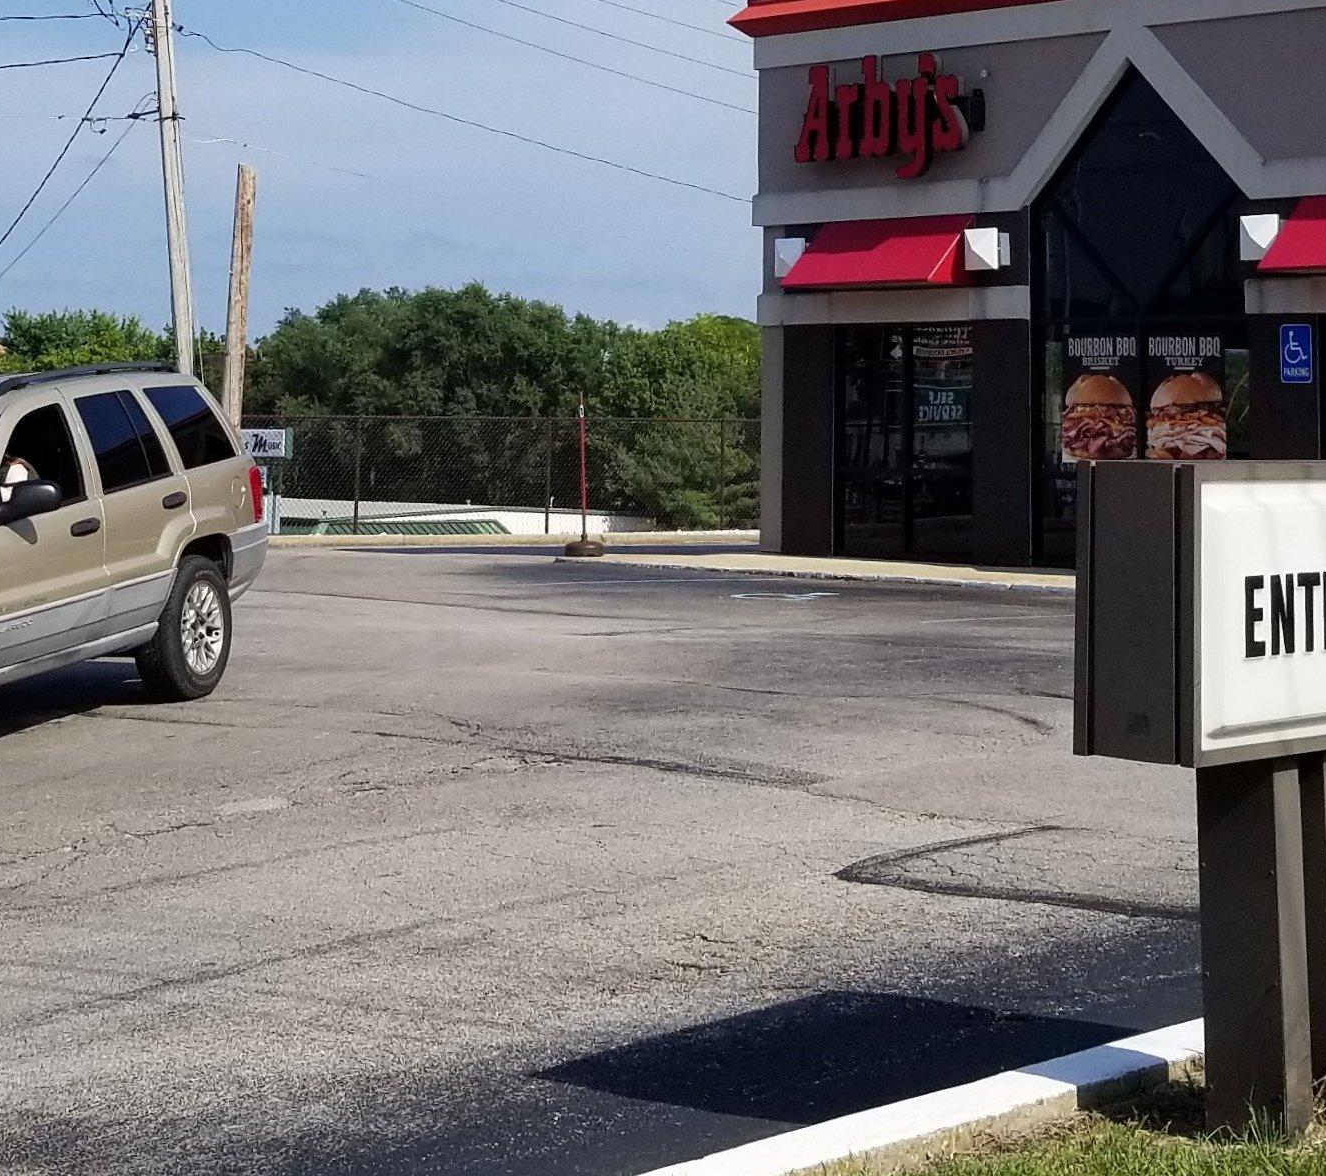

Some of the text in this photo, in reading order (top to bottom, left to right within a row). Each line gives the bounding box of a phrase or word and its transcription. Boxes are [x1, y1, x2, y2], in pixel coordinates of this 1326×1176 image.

[793, 52, 964, 180] Arby's
[1068, 336, 1137, 358] BOURBON BBQ
[1148, 336, 1221, 358] BOURBON BBQ
[1082, 357, 1120, 367] BRISKET
[1165, 356, 1204, 367] TURKEY
[1283, 367, 1310, 377] PARKING
